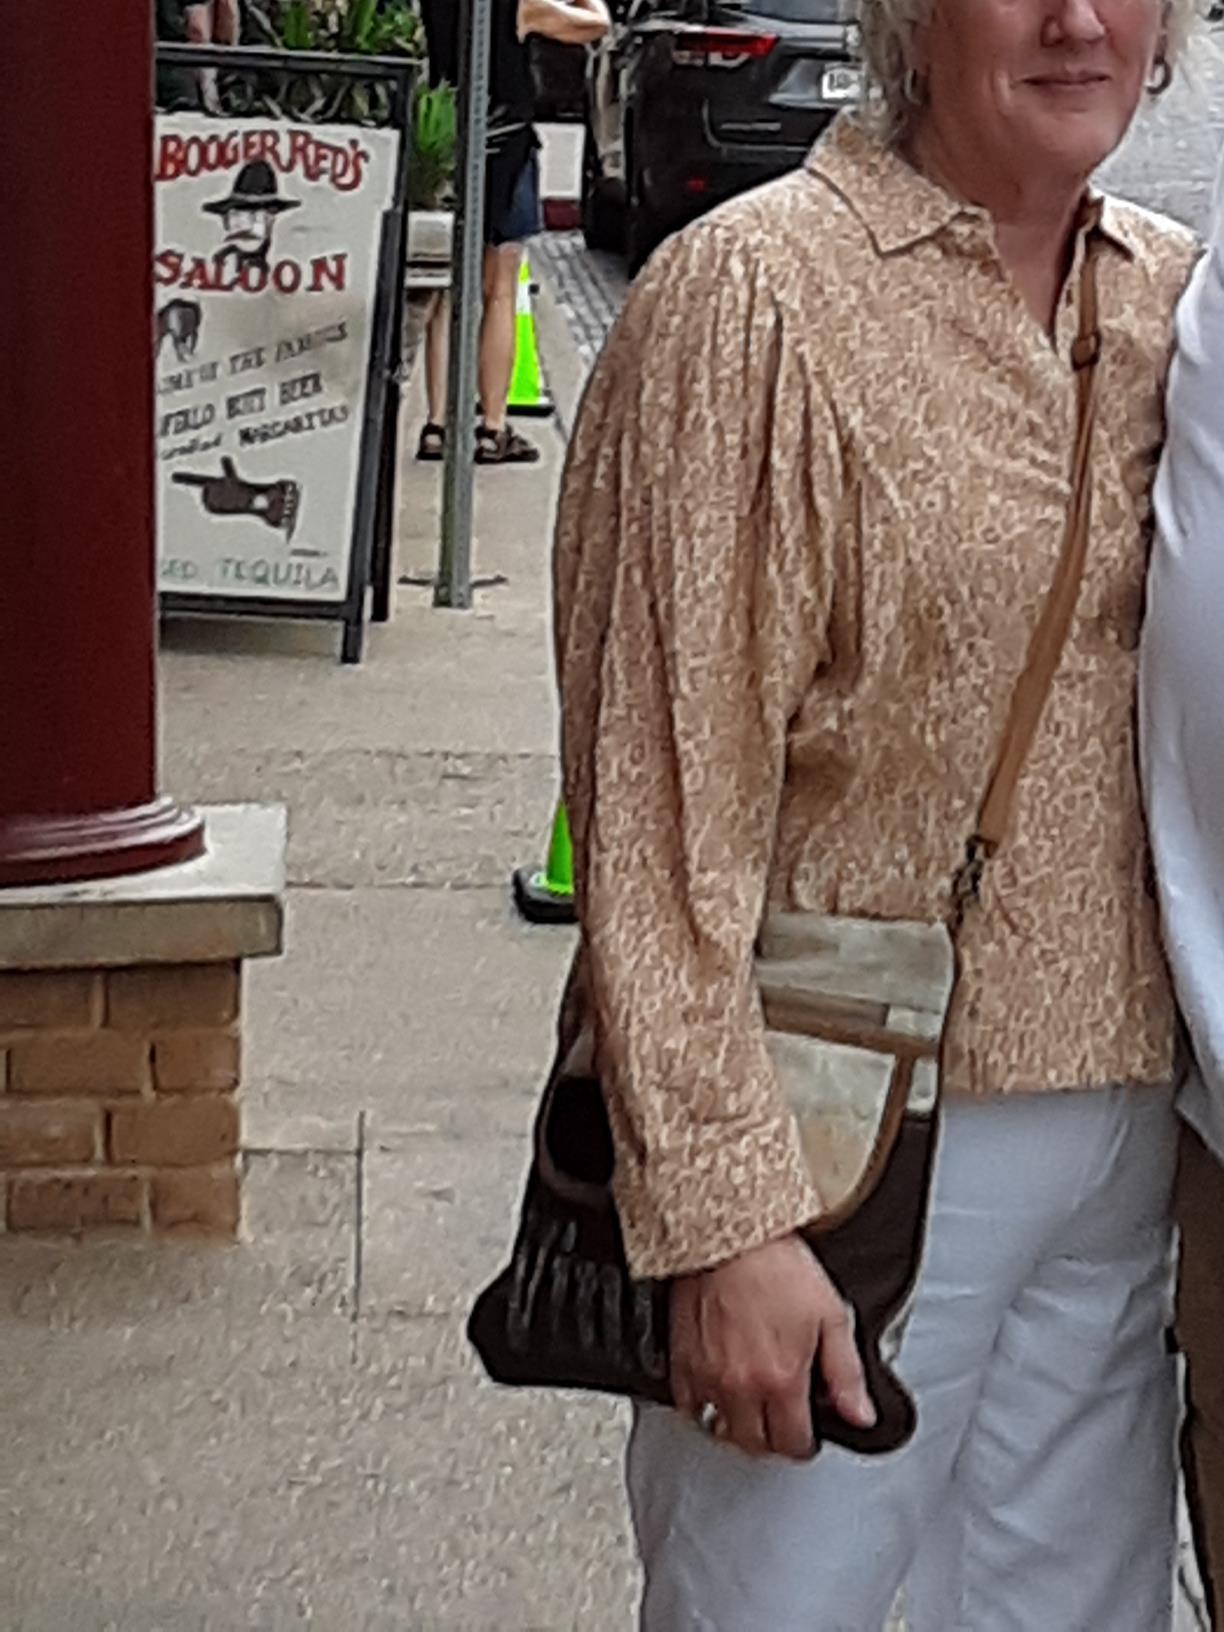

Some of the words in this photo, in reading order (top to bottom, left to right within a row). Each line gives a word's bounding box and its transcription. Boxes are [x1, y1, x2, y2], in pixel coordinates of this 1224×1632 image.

[155, 129, 285, 182] BOOGER
[286, 129, 370, 192] RED'S
[155, 248, 348, 294] SALOON
[219, 555, 340, 594] TEQUILA
